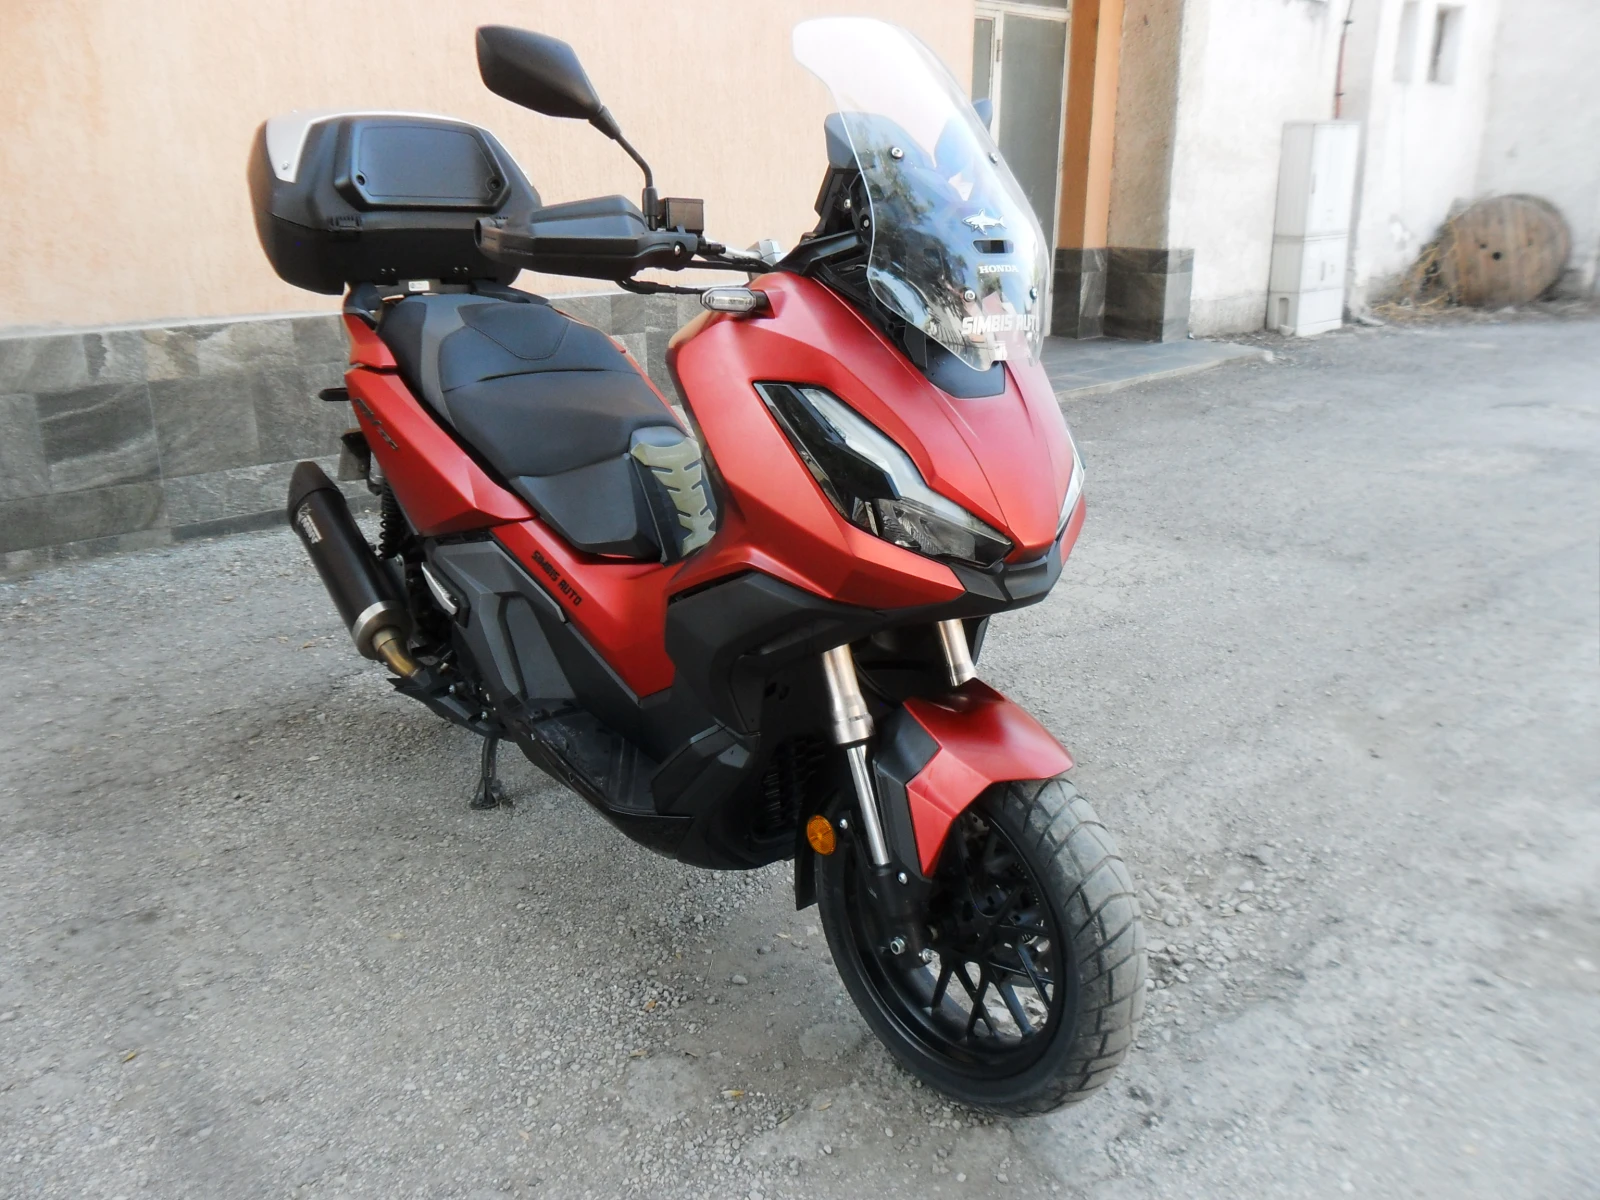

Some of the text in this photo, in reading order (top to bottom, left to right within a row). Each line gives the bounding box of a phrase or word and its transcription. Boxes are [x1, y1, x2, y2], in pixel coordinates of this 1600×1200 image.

[979, 264, 1019, 274] HONDA
[961, 313, 1014, 335] SIMBIS
[559, 579, 583, 606] AUTO
